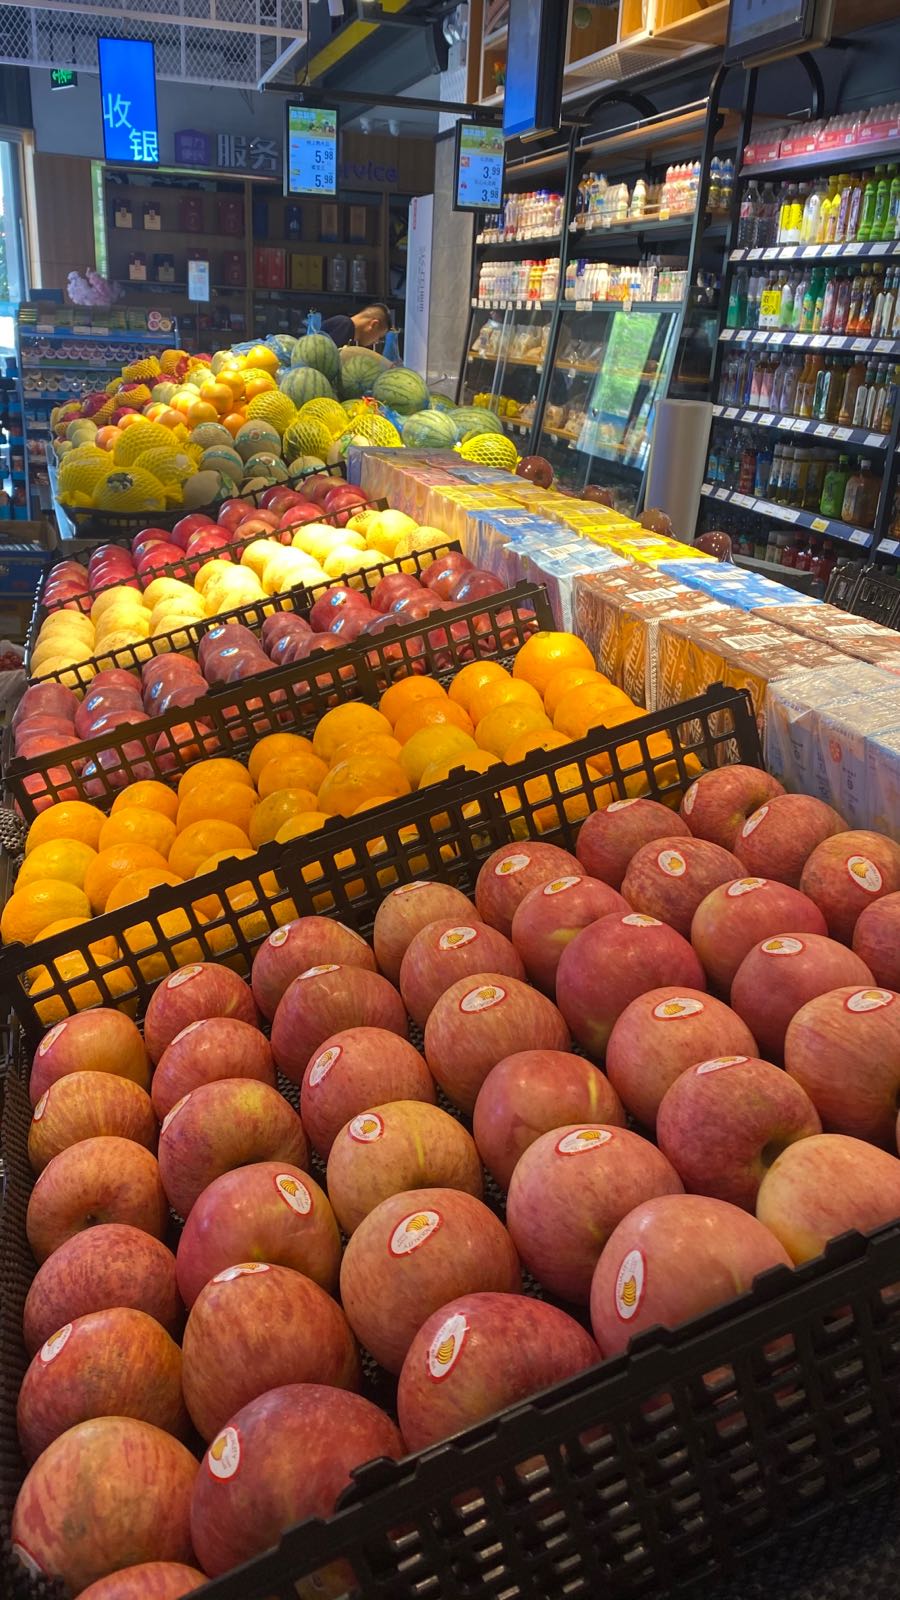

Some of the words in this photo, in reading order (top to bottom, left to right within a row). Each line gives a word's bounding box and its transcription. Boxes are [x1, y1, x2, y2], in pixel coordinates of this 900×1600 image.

[217, 133, 278, 170] 服务
[314, 150, 334, 164] 5.98
[343, 160, 400, 183] rvice
[482, 166, 501, 179] 3.99
[314, 174, 334, 188] 5.98
[481, 189, 499, 202] 3.98
